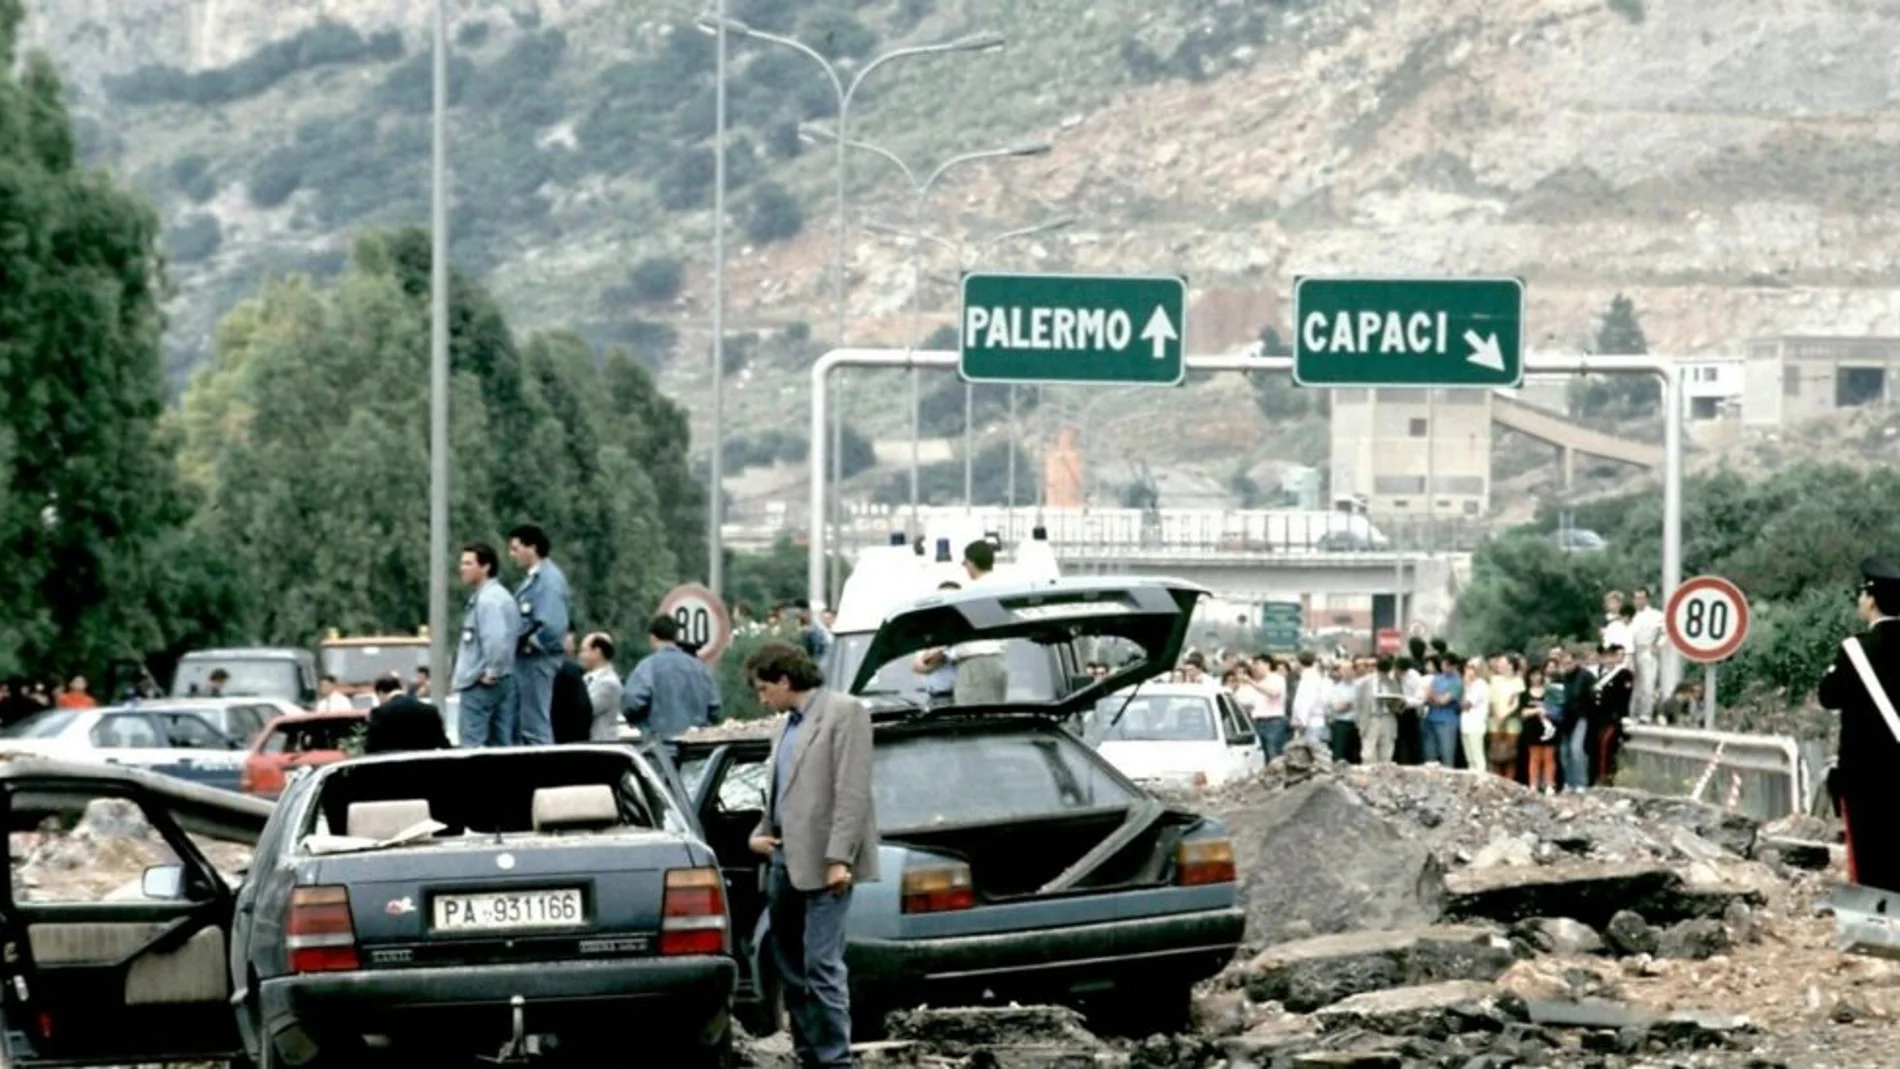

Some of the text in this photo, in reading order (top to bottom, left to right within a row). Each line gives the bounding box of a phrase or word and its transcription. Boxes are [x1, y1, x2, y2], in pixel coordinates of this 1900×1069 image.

[965, 305, 1132, 351] PALERMO
[1303, 310, 1447, 354] CAPACI
[675, 606, 709, 650] 80
[1685, 598, 1728, 640] 80
[443, 894, 576, 924] PA 931166
